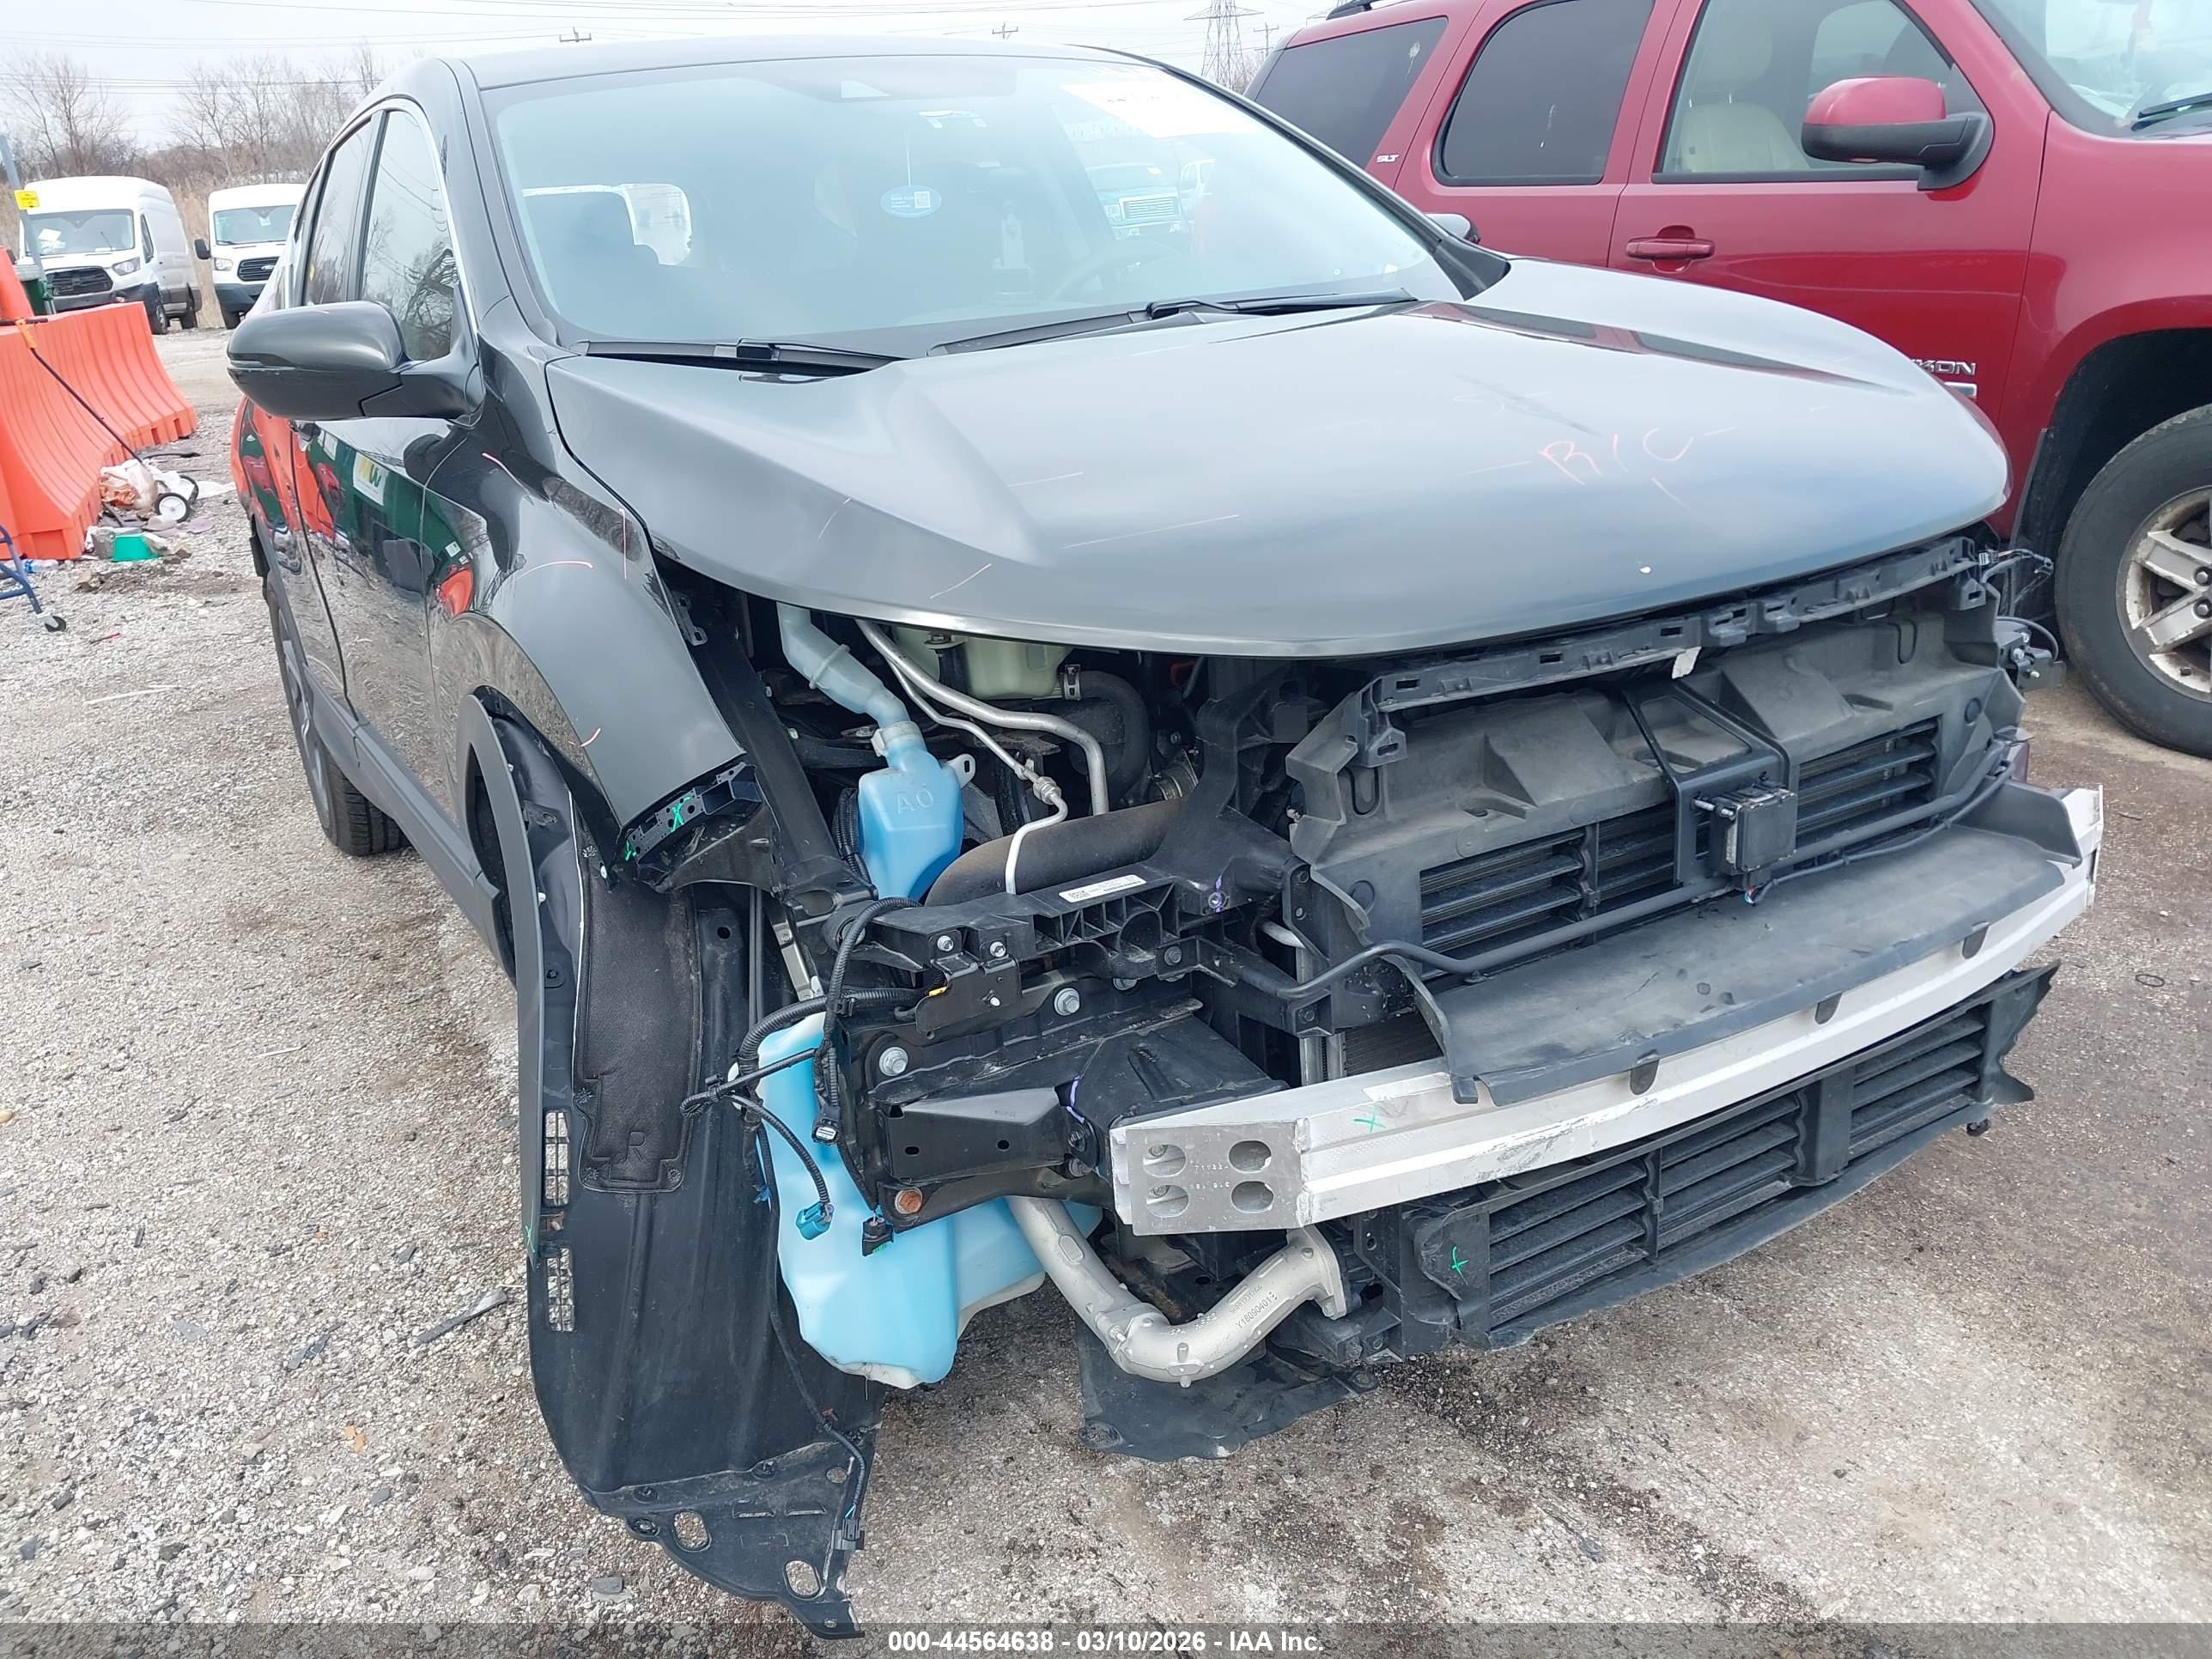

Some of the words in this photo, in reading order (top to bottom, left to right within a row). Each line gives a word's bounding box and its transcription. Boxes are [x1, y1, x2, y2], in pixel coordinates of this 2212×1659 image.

[1376, 154, 1400, 163] SLT
[1912, 359, 1977, 375] KON
[626, 1130, 646, 1161] R
